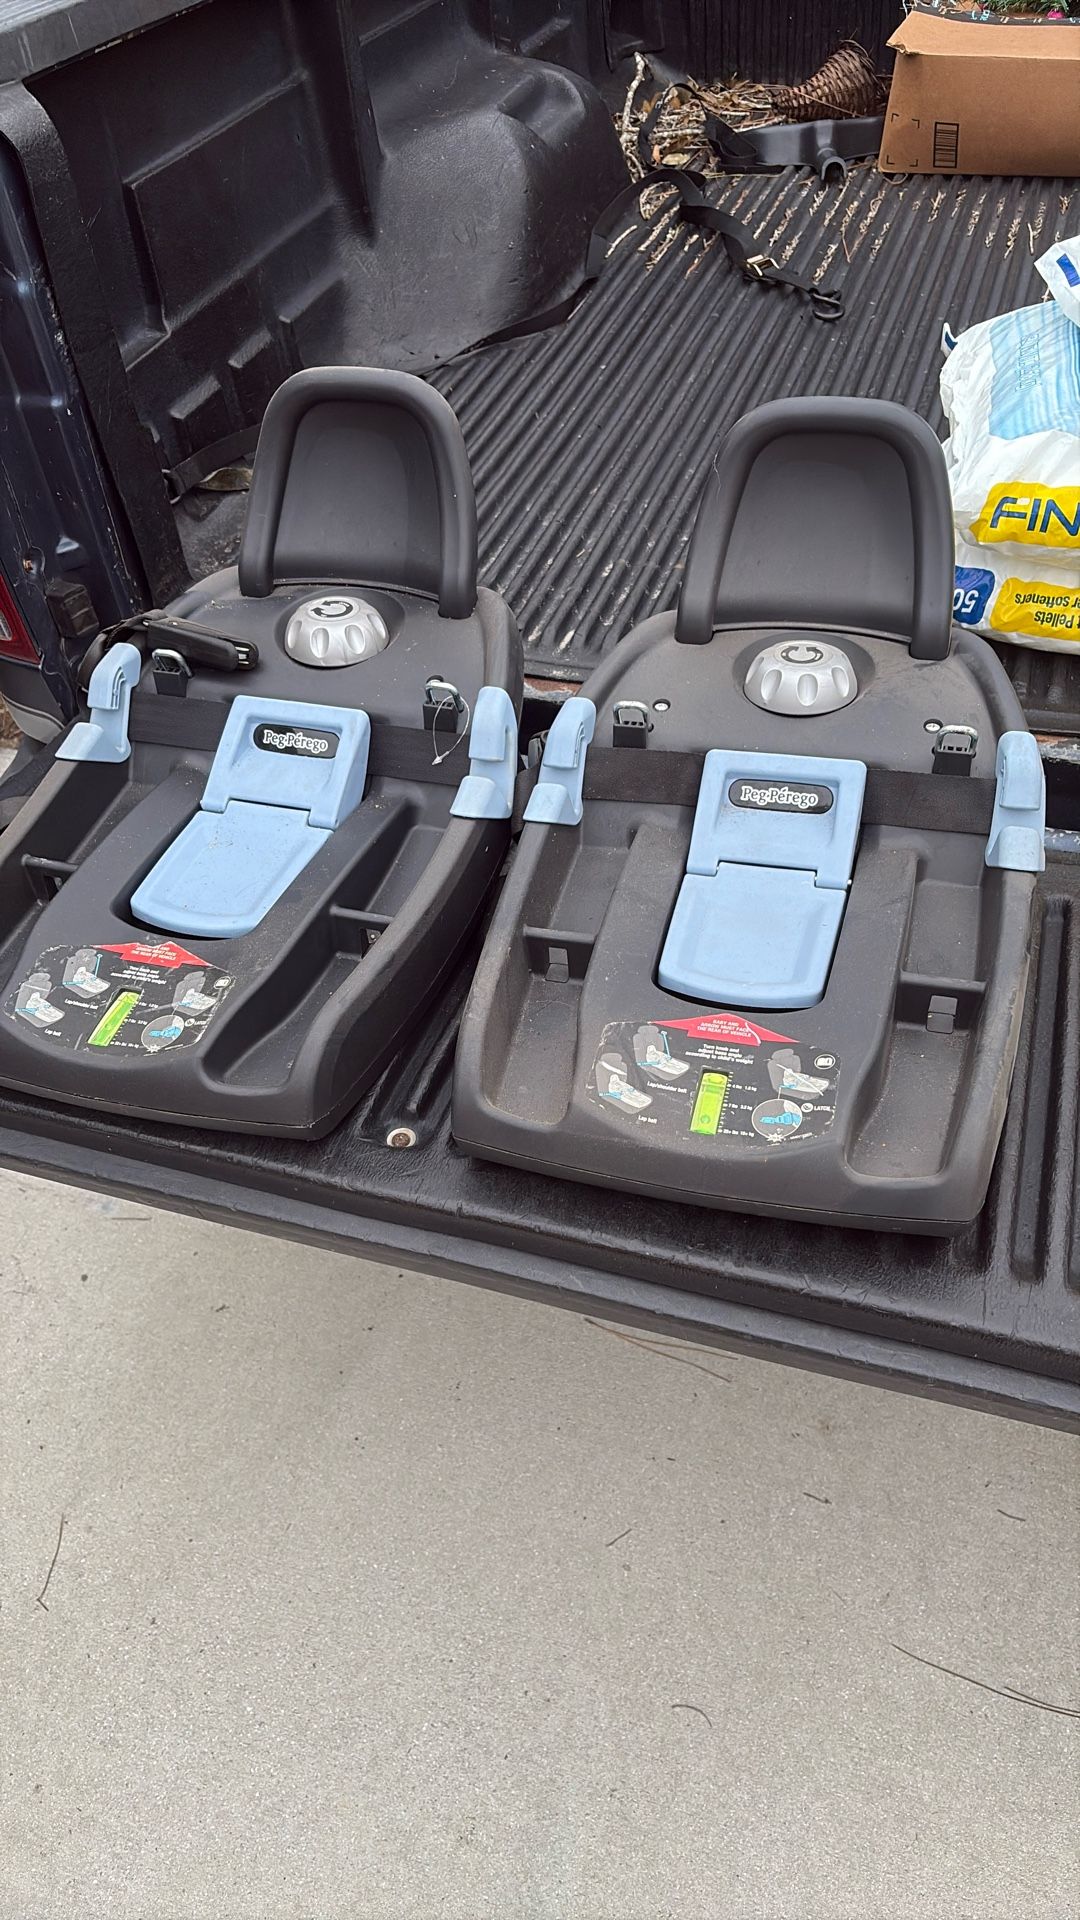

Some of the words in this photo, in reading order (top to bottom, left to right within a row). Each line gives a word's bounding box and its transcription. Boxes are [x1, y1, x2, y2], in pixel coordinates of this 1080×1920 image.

[1015, 593, 1070, 608] softeners
[1034, 611, 1074, 629] Pellets
[647, 1081, 678, 1092] Lap/shoulder
